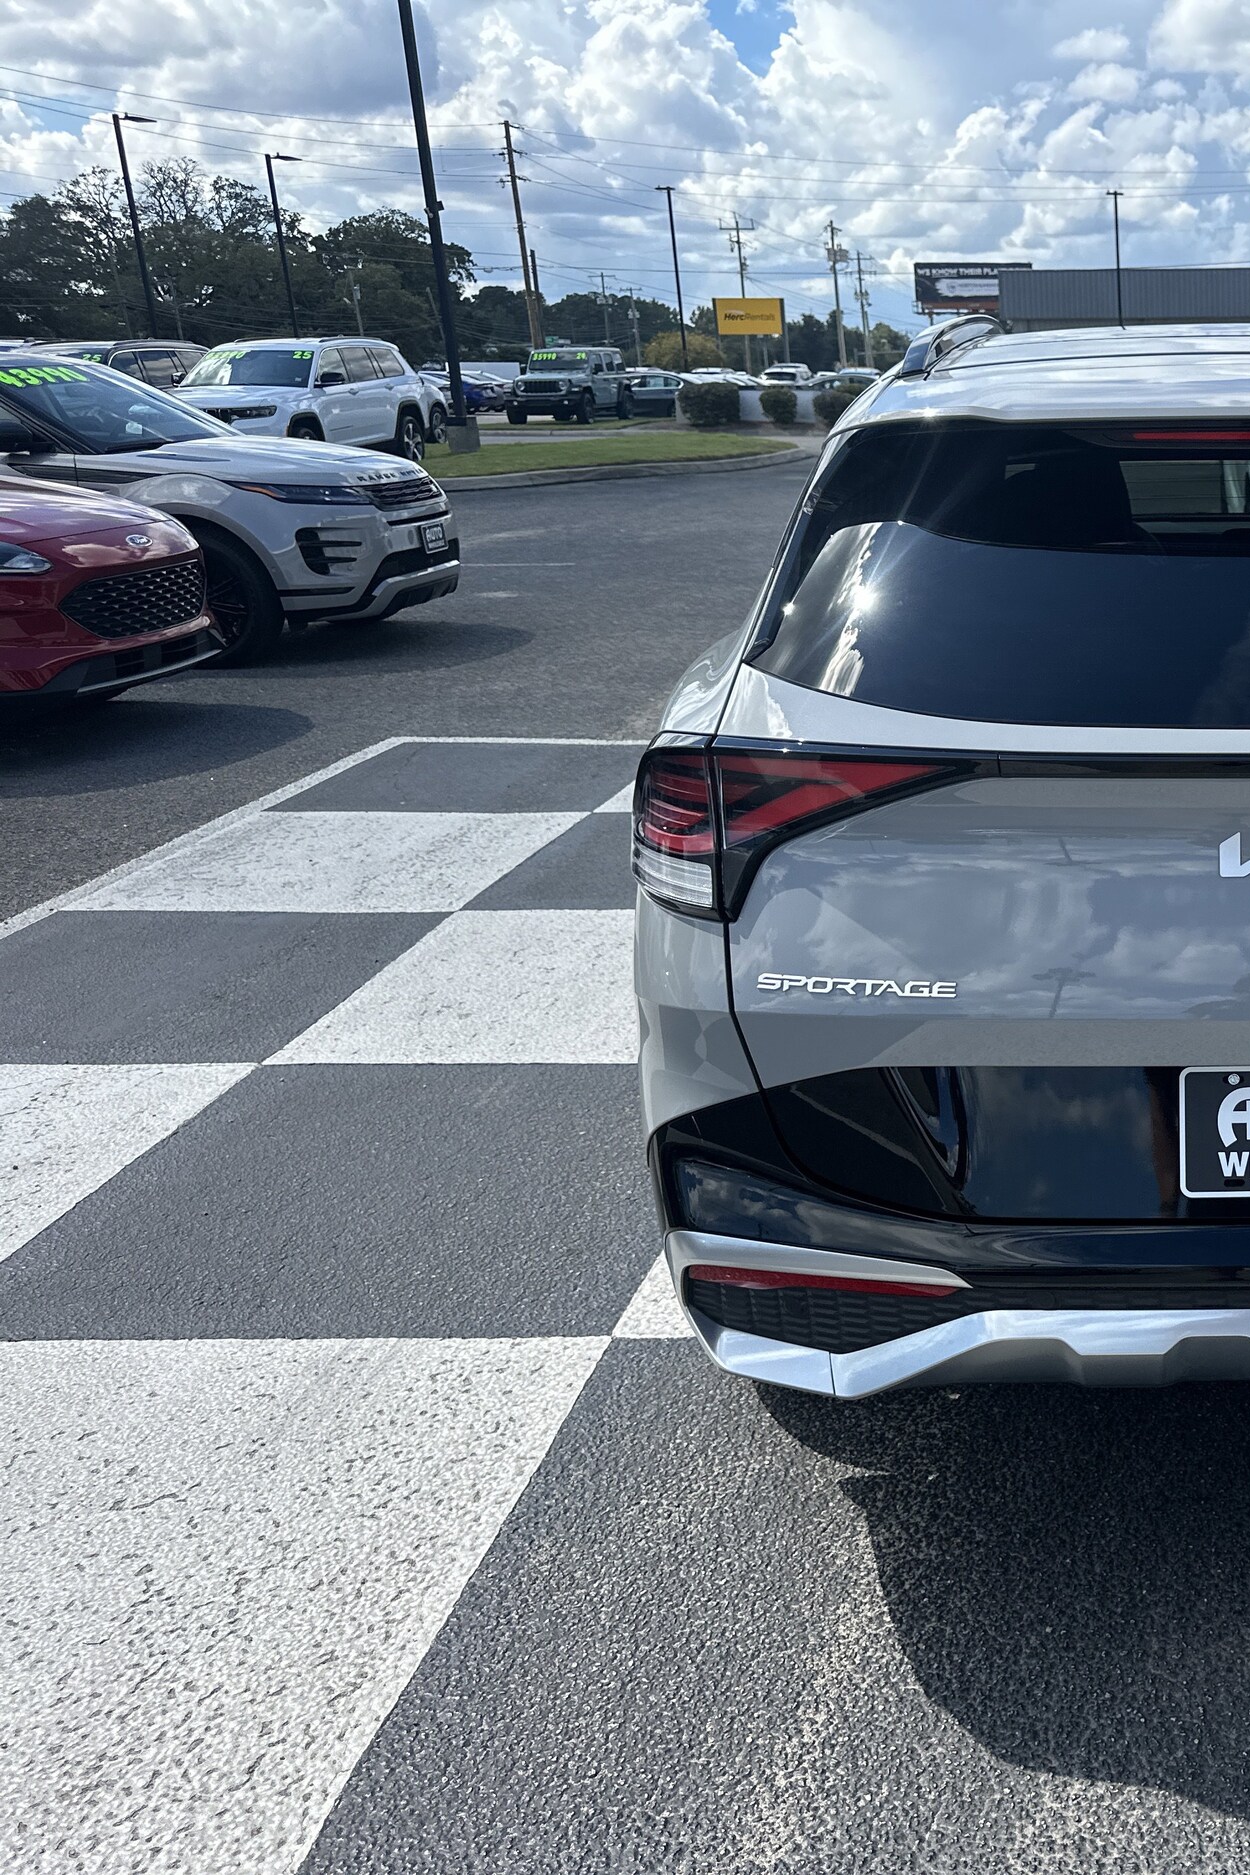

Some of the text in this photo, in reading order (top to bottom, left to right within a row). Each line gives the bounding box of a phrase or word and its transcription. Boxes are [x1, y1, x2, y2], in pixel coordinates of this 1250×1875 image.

[931, 268, 958, 277] KNOW
[959, 267, 983, 276] THEIR
[983, 267, 999, 276] PLA
[82, 353, 102, 362] 25
[292, 351, 313, 359] 25
[757, 972, 957, 998] SPORTAGE
